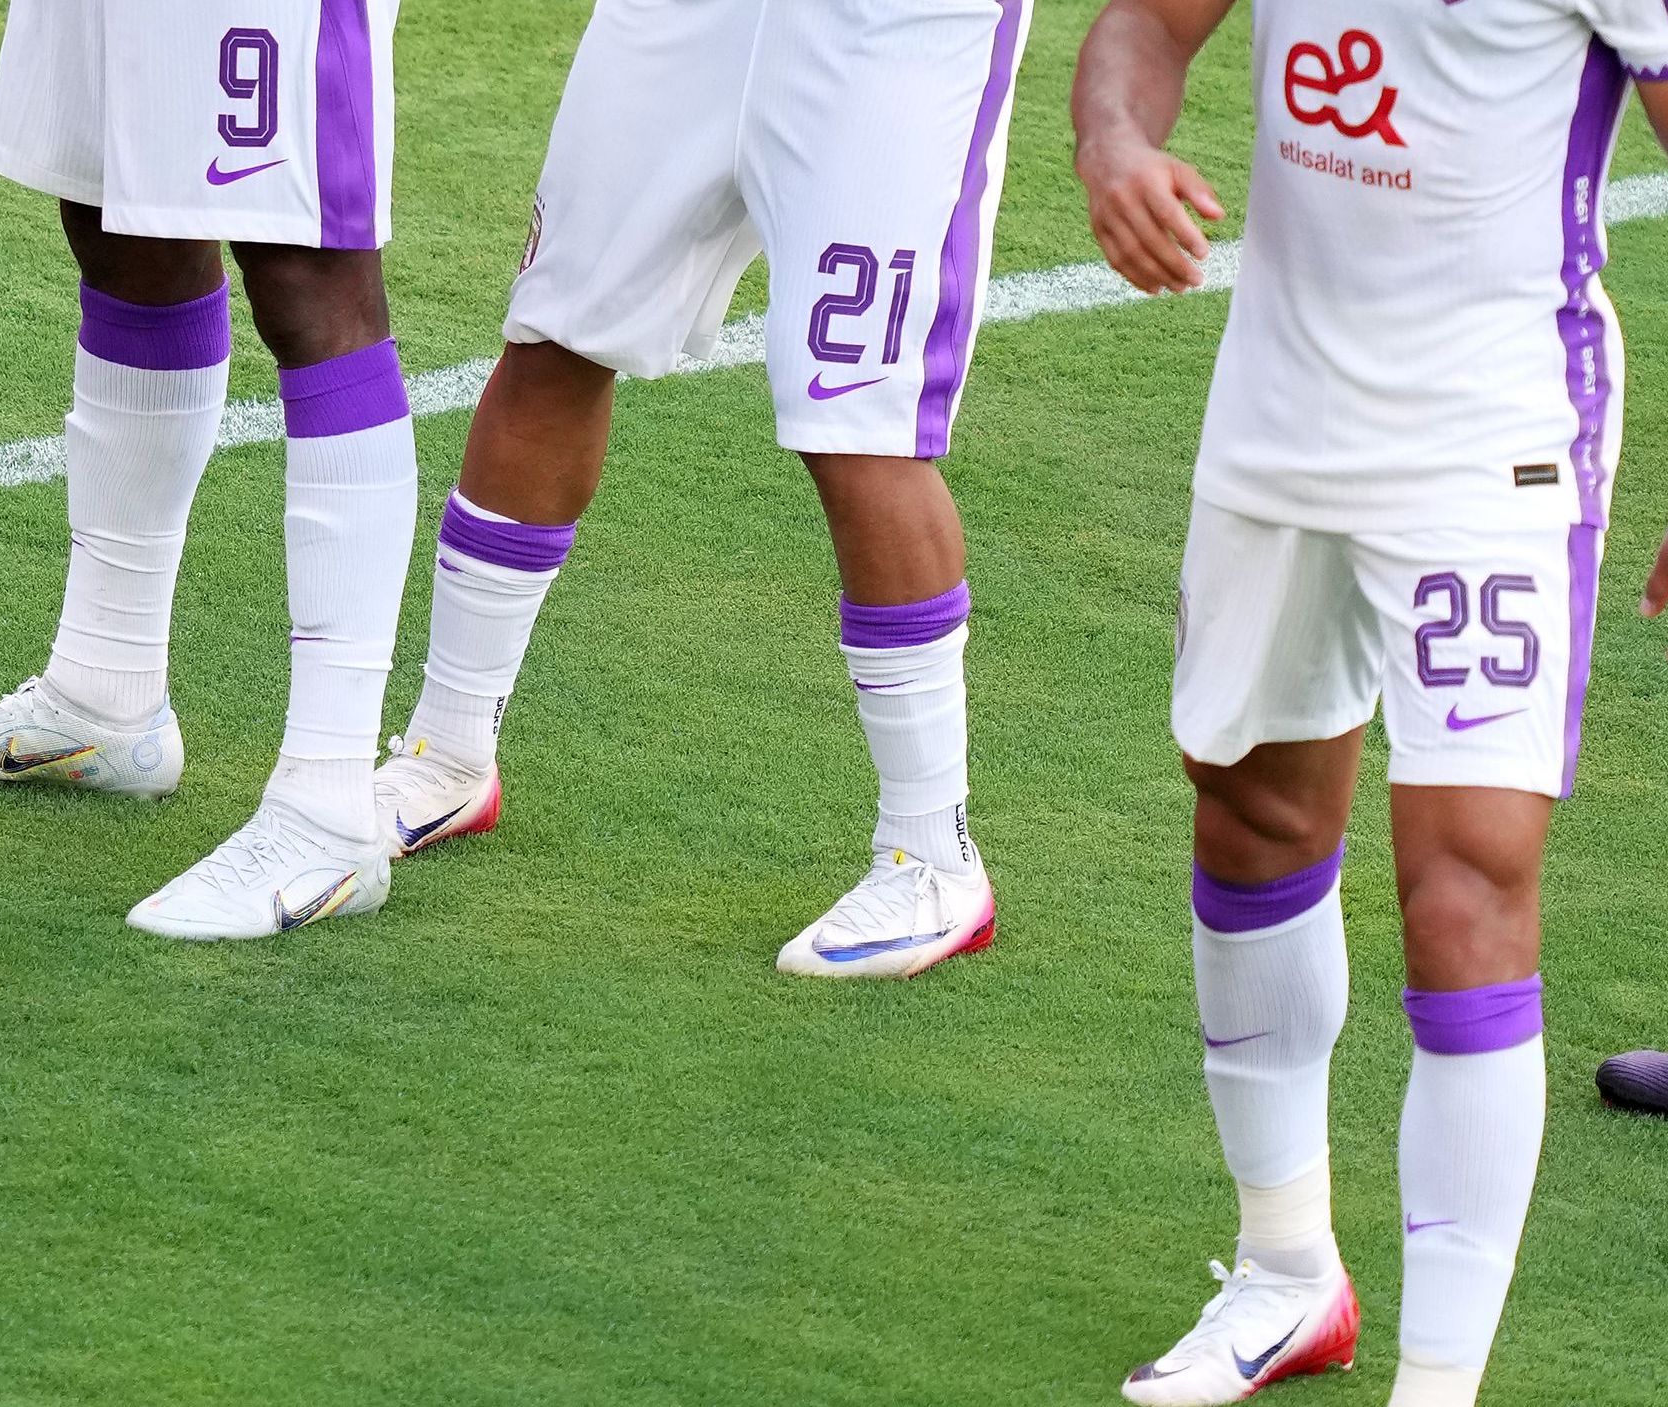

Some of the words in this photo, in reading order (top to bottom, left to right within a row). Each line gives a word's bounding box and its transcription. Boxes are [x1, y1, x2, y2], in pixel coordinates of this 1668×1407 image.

[218, 27, 279, 148] 9
[1279, 139, 1354, 181] etisalat
[1361, 165, 1413, 190] and
[807, 242, 916, 365] 21
[1413, 571, 1540, 689] 25
